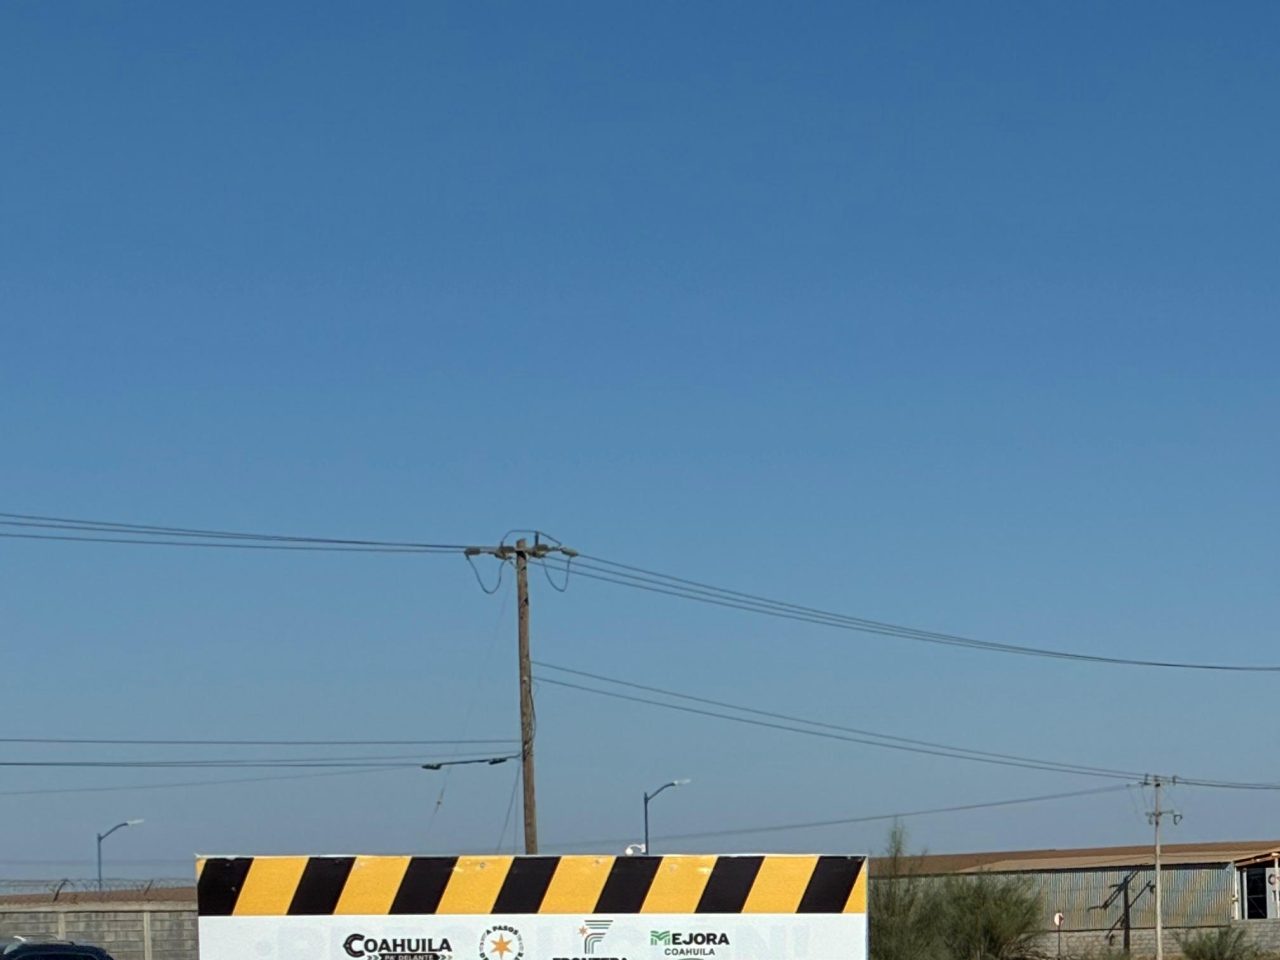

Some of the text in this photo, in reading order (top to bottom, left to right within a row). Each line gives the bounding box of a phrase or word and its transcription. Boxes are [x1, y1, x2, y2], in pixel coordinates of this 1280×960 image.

[492, 925, 519, 936] PASOS
[651, 930, 731, 946] MEJORA
[343, 934, 453, 958] COAHUILA
[664, 947, 716, 956] COAHUILA
